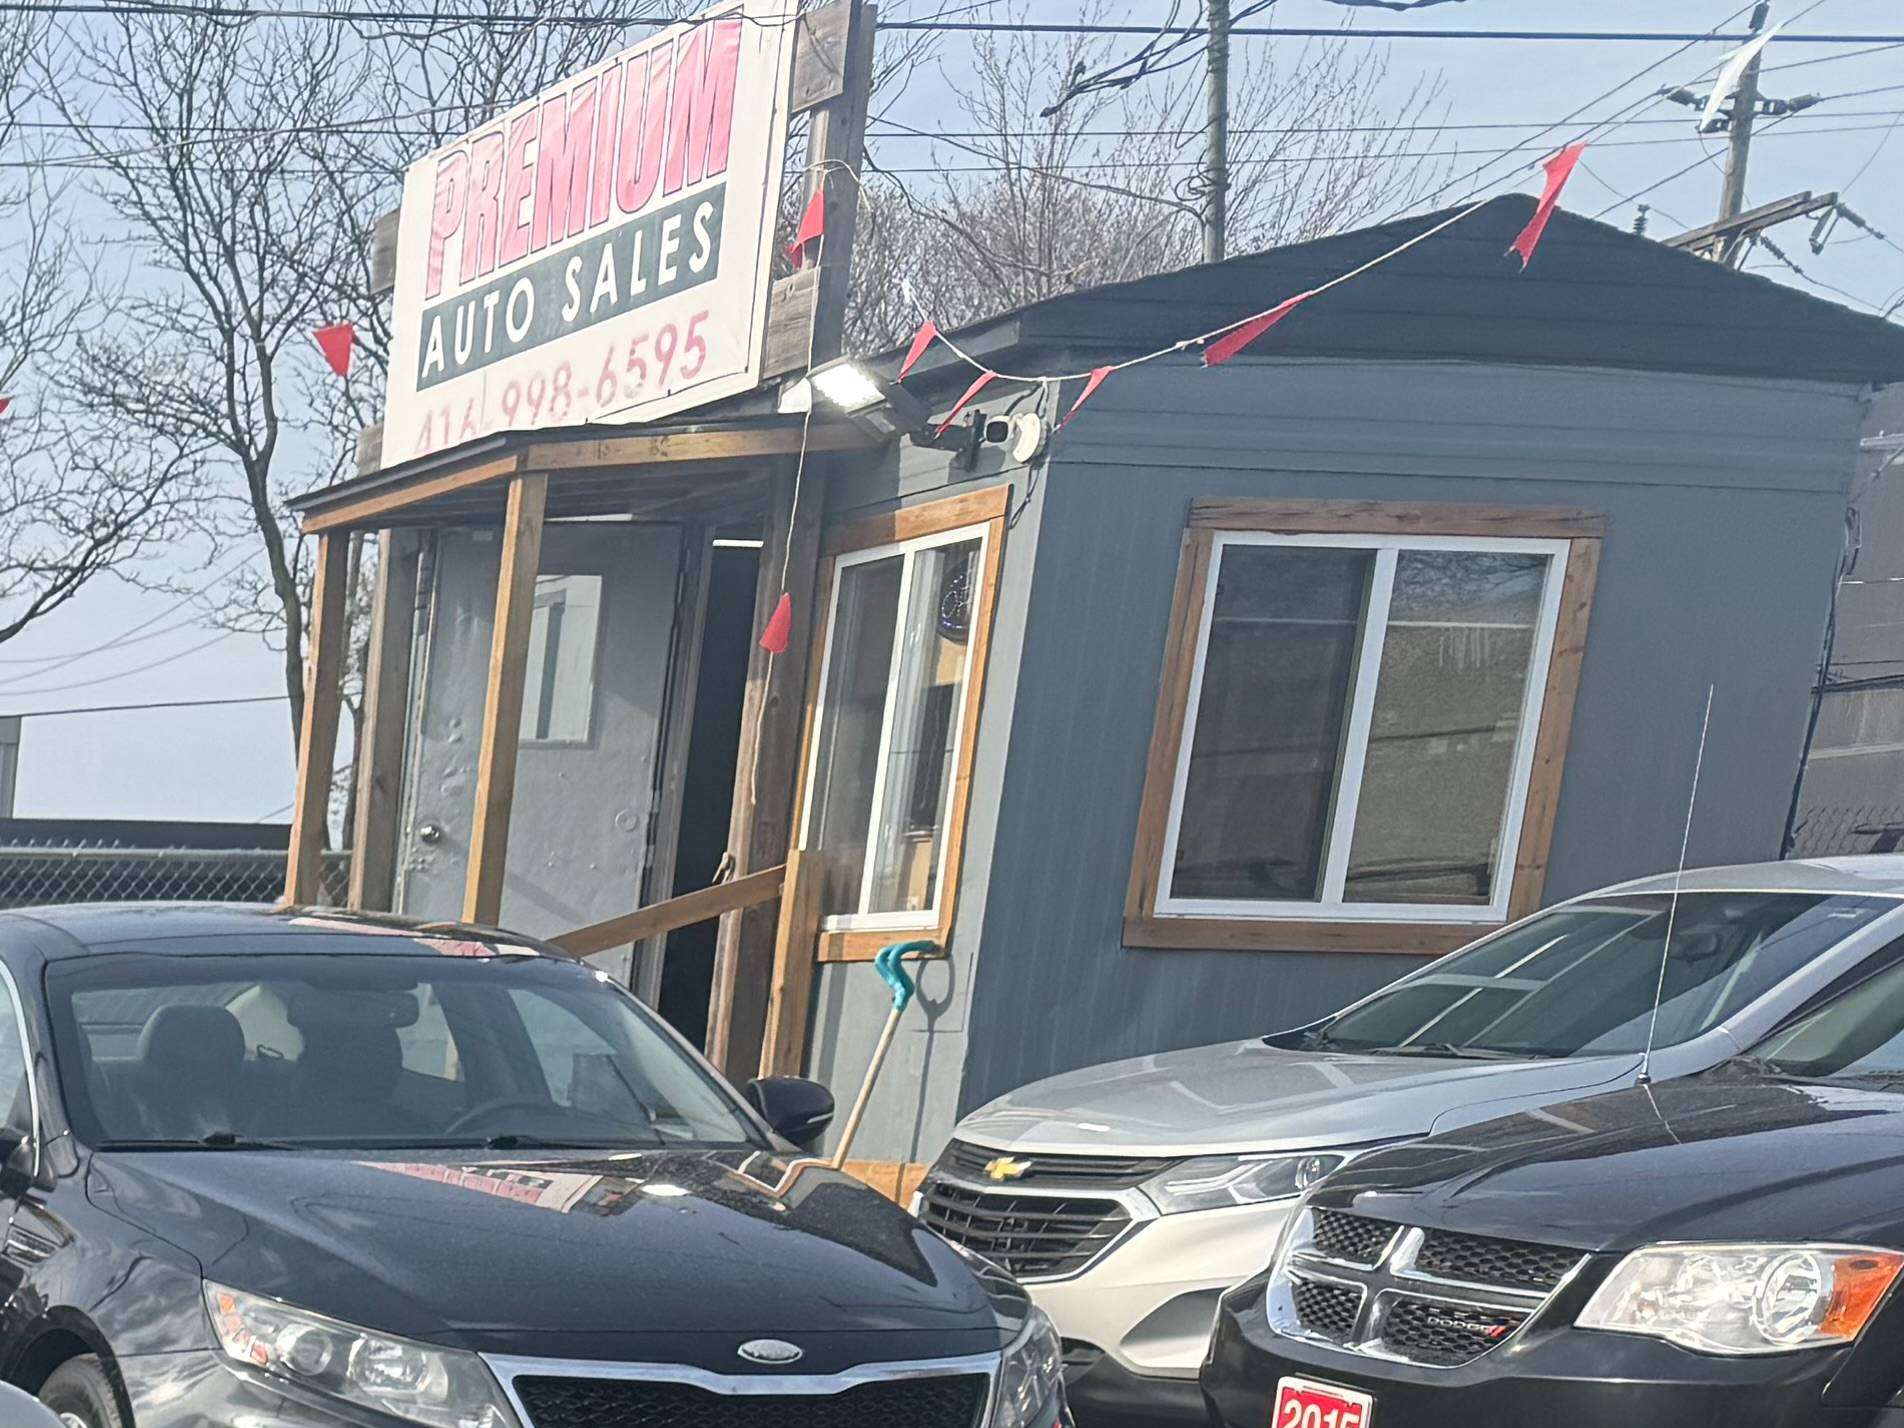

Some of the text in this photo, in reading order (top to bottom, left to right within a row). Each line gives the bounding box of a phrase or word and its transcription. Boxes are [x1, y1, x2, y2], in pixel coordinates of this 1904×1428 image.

[424, 16, 743, 300] PREMIUM
[421, 200, 716, 379] AUTO SALES
